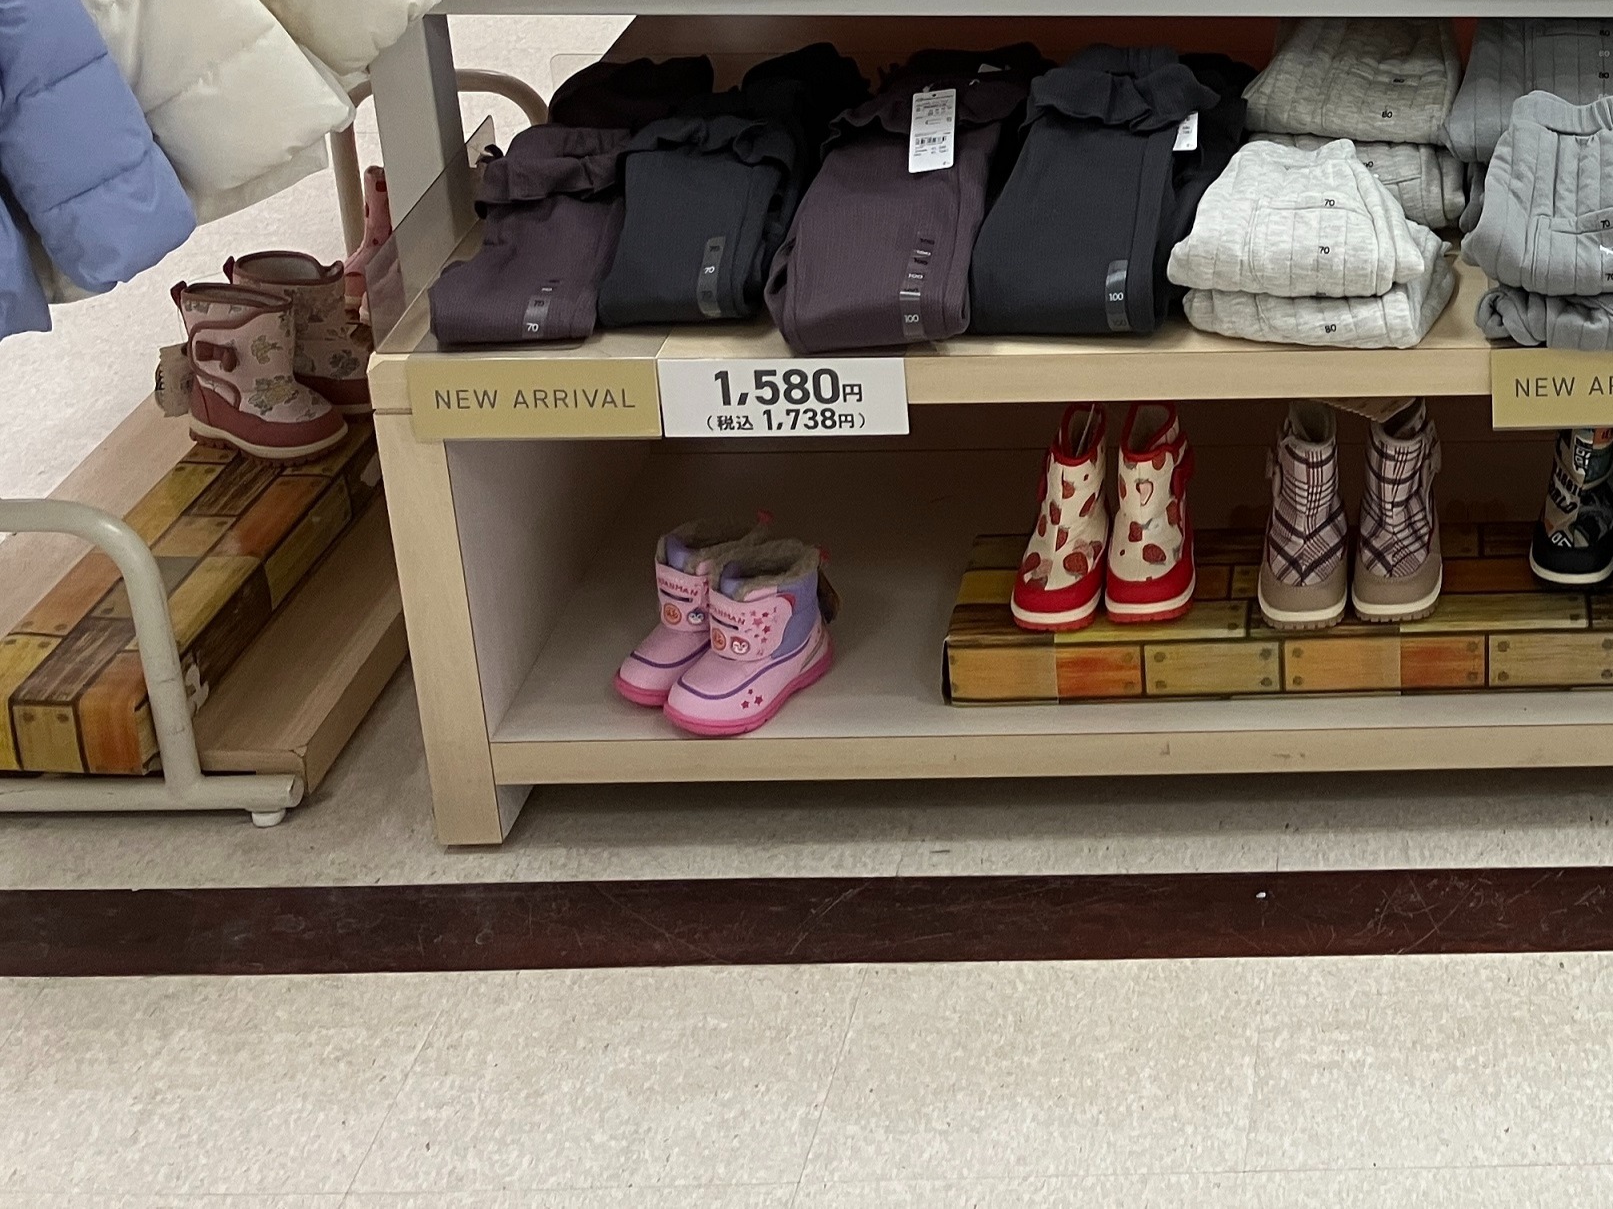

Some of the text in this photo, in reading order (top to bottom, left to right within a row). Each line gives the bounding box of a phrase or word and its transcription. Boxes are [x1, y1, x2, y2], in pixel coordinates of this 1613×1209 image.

[1324, 199, 1335, 207] 70
[1601, 220, 1611, 228] 70
[1319, 246, 1330, 255] 70
[1108, 292, 1124, 301] 100
[904, 314, 919, 323] 100
[526, 322, 539, 332] 70
[1324, 324, 1337, 333] 80
[714, 369, 863, 407] 1,580円
[1514, 376, 1576, 397] NEW
[434, 388, 636, 409] NEW ARRIVAL
